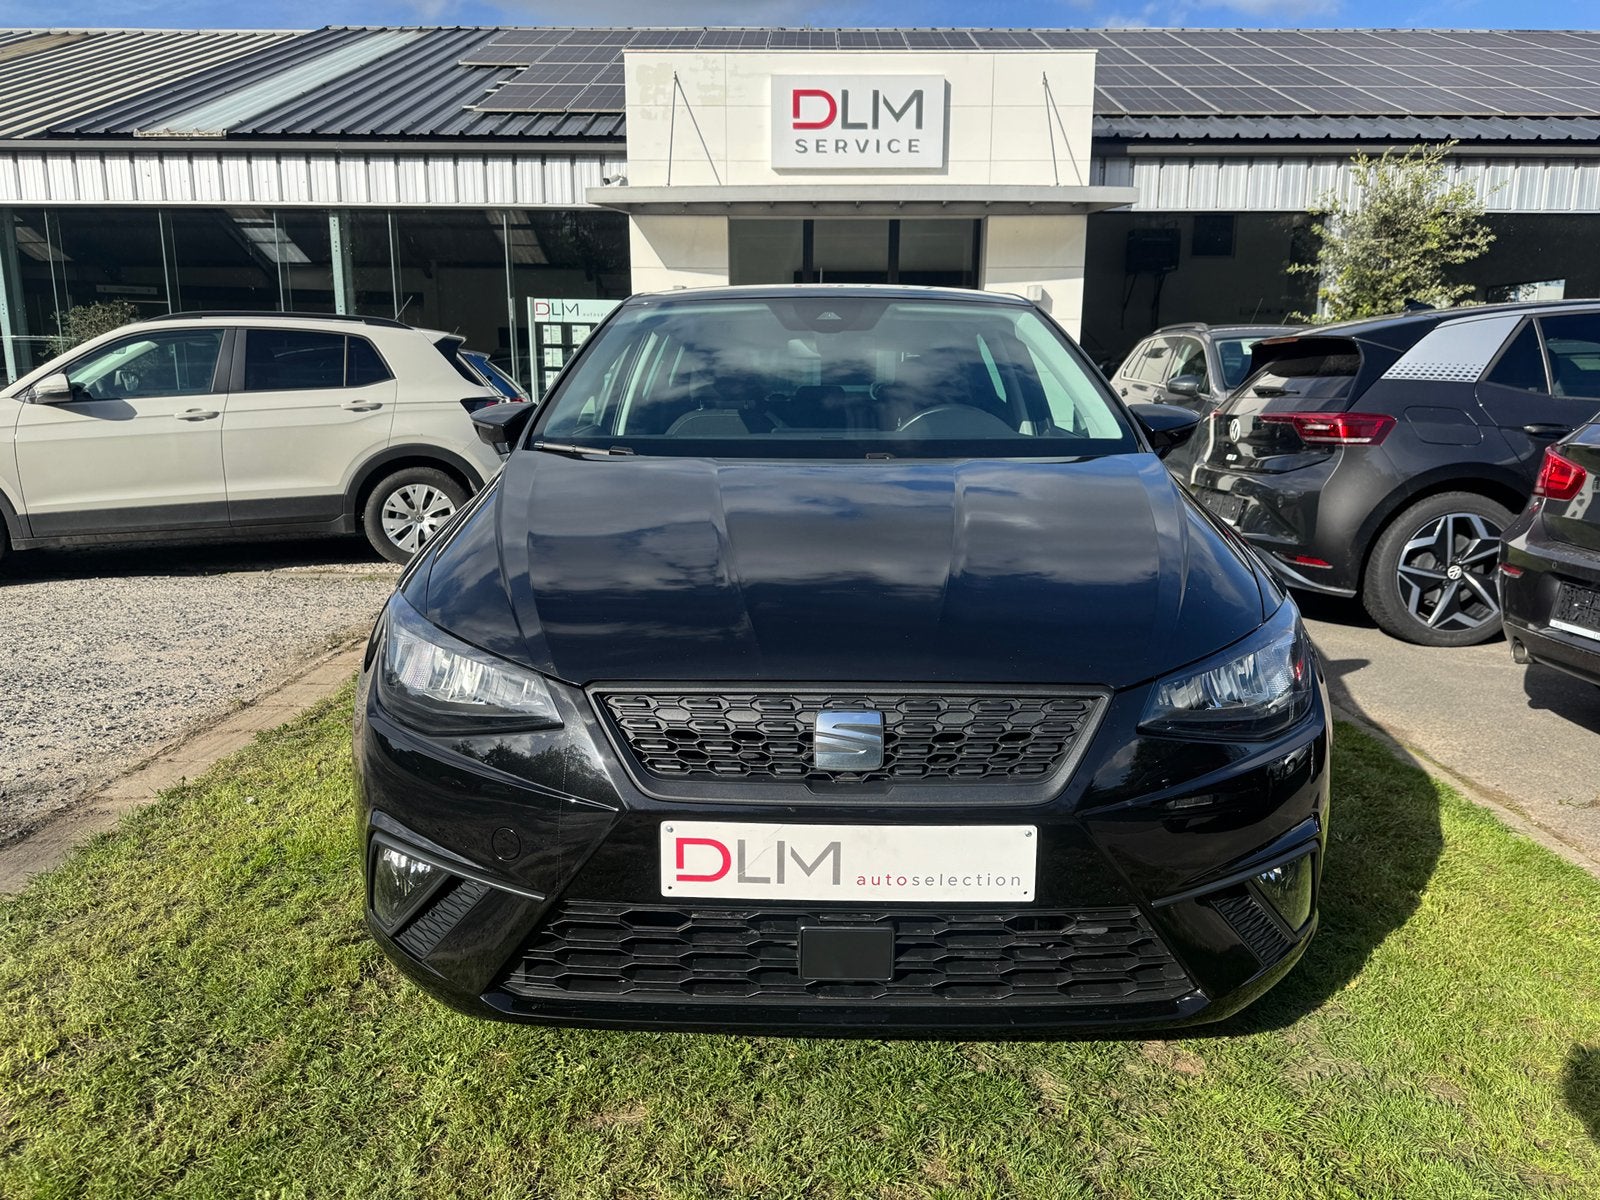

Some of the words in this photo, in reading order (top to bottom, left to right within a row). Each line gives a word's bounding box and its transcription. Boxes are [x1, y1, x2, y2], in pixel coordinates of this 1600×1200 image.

[792, 89, 924, 130] DLM
[794, 138, 921, 154] SERVICE
[535, 302, 580, 317] DLM
[675, 837, 841, 886] DLM
[856, 872, 1021, 887] autoselection
